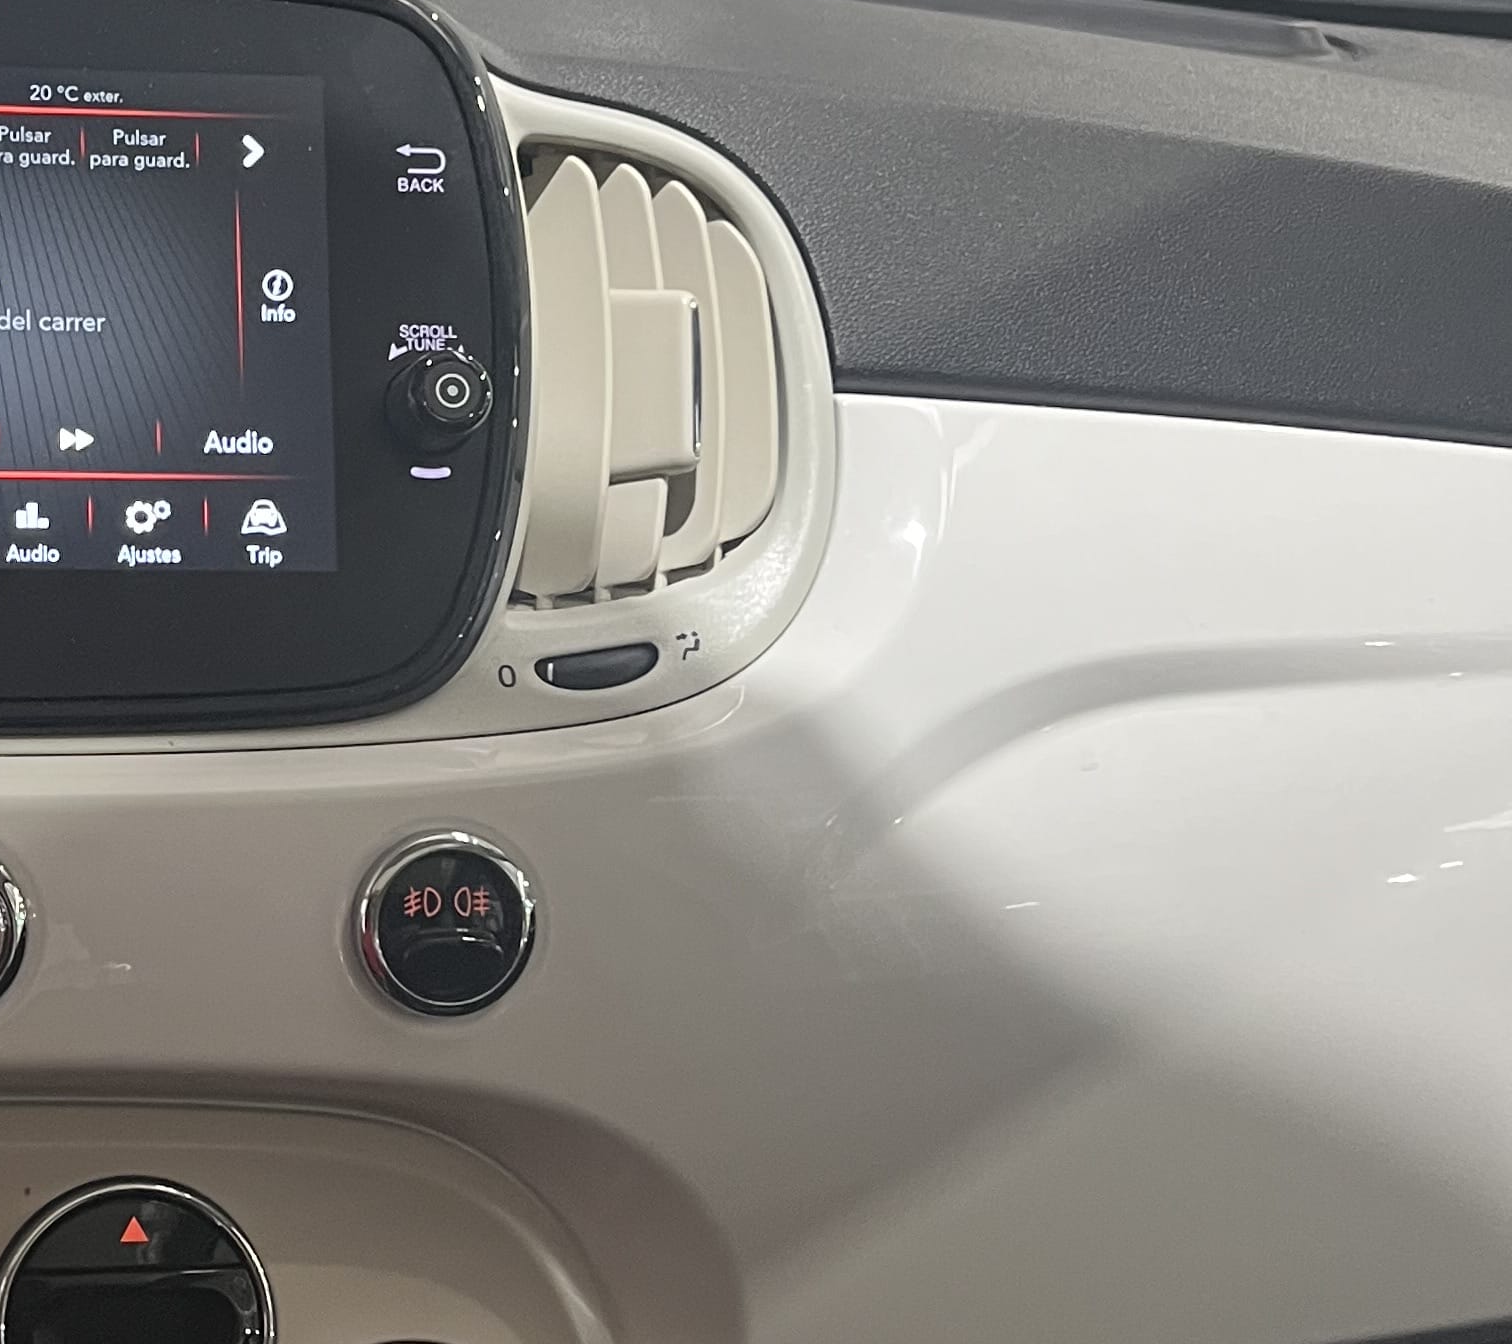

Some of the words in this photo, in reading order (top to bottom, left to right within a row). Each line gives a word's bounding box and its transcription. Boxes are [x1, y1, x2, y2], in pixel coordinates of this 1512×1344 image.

[30, 85, 51, 100] 20
[57, 86, 78, 101] °C
[84, 92, 122, 102] exter.
[114, 129, 166, 146] Pulsar
[19, 149, 75, 167] guard.
[90, 155, 128, 169] para
[135, 152, 189, 171] guard.
[398, 178, 444, 192] BACK
[262, 303, 295, 322] Info
[39, 317, 105, 331] carrer
[399, 324, 457, 339] SCROLL
[406, 337, 445, 351] TUNE
[204, 430, 273, 454] Audio
[6, 544, 59, 562] Audio
[118, 545, 181, 566] Ajustes
[247, 545, 282, 567] Trip
[498, 664, 516, 687] 0
